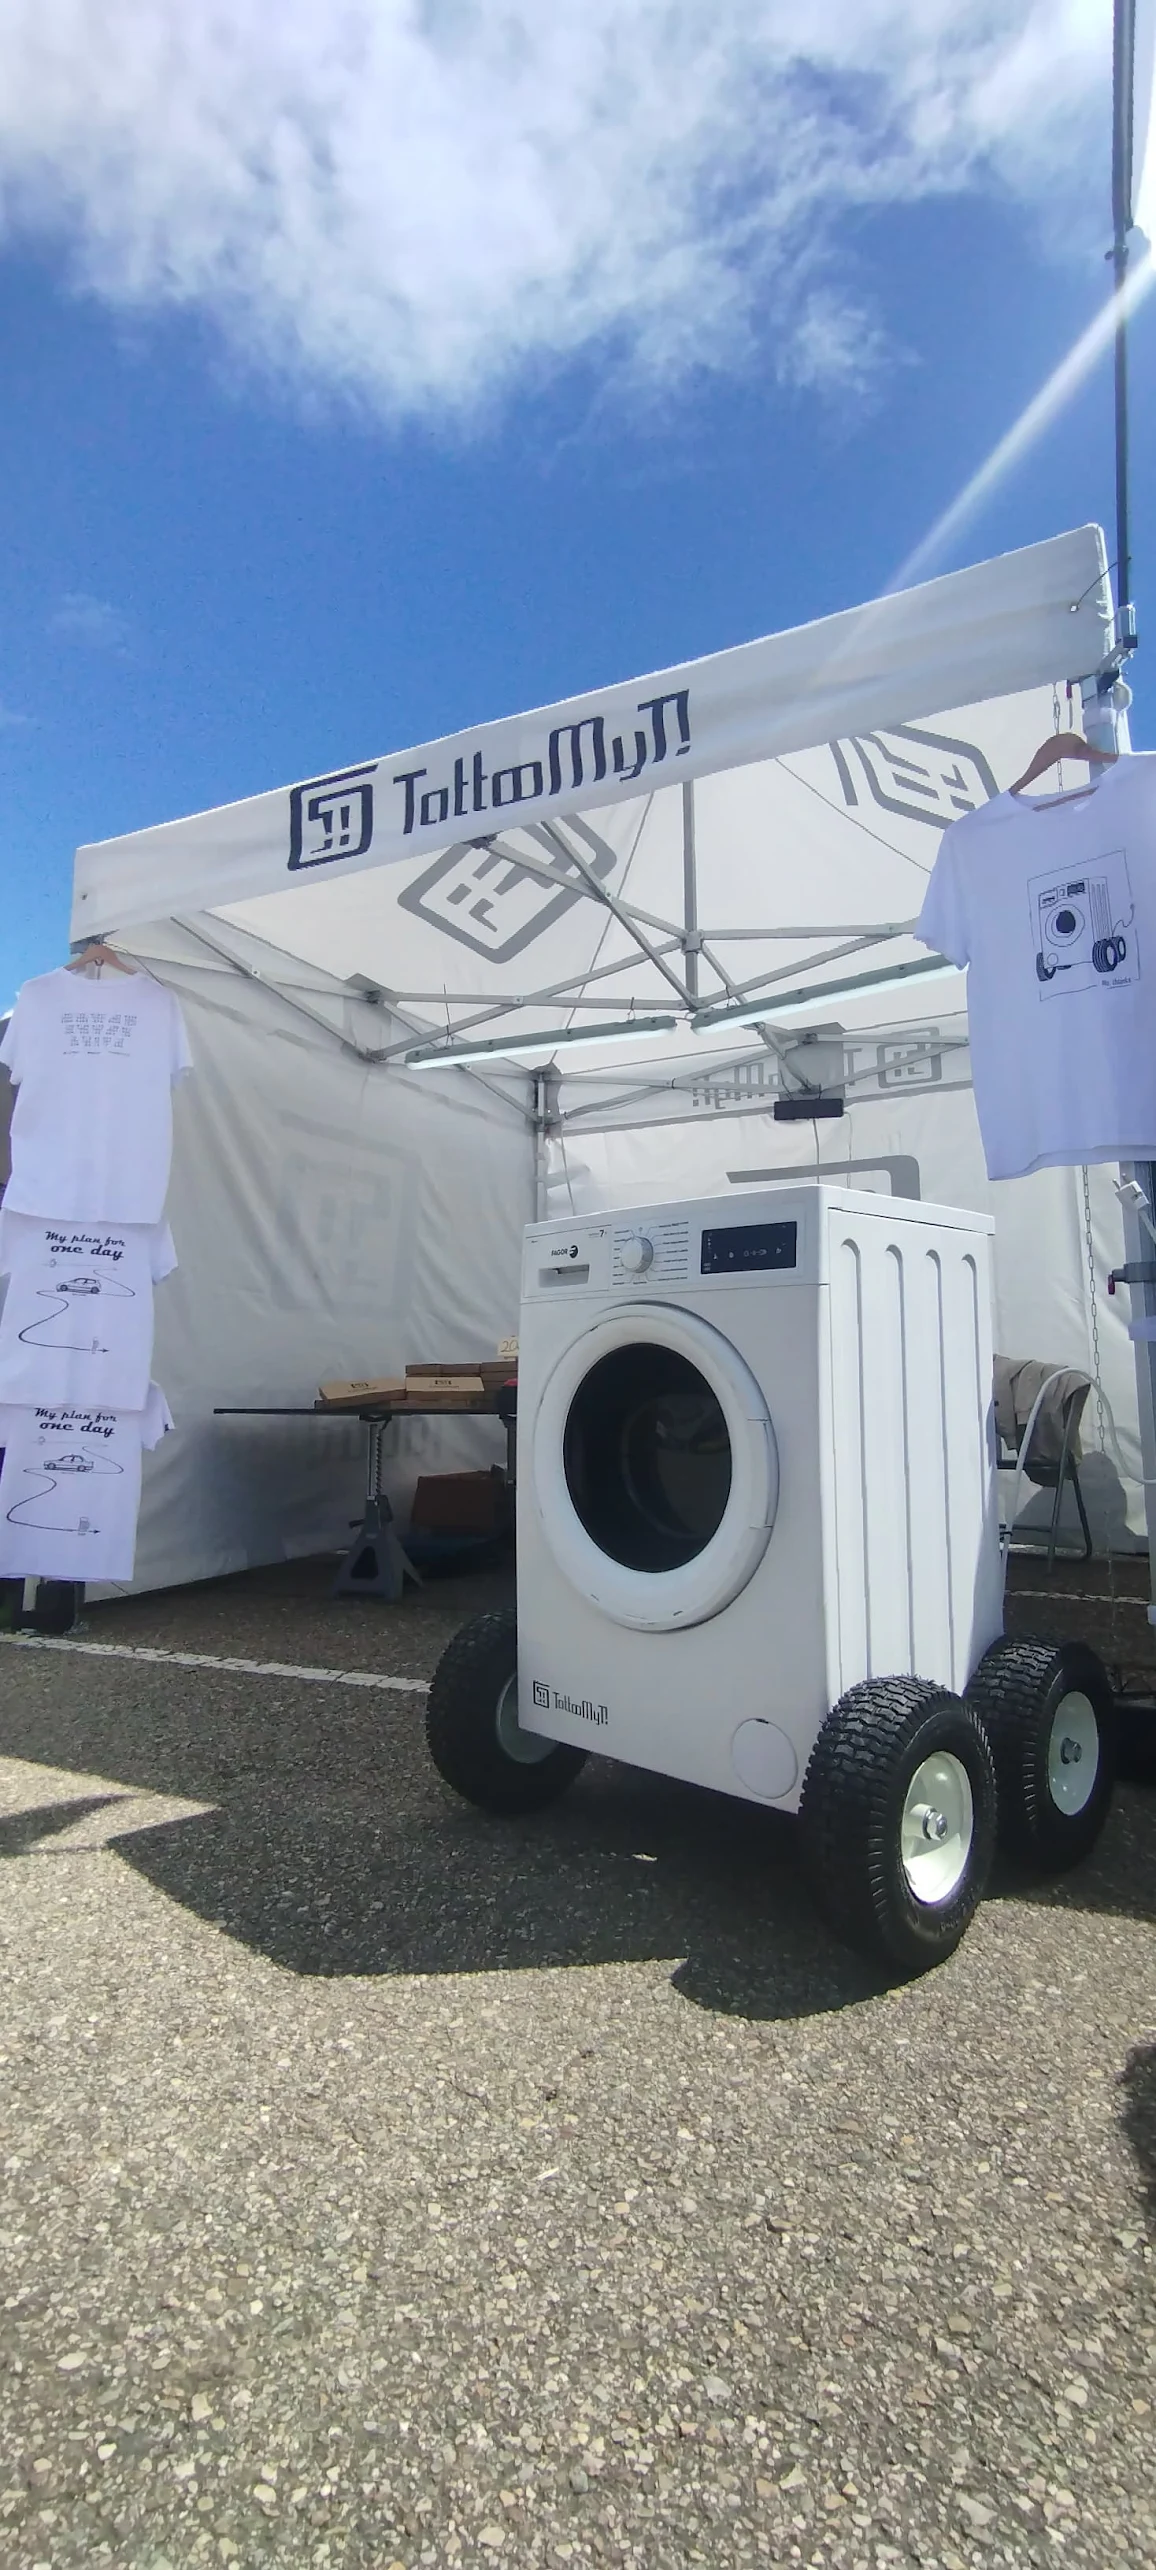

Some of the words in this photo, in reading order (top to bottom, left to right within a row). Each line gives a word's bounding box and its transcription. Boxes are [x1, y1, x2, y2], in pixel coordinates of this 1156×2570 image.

[45, 1231, 68, 1243] My
[71, 1234, 102, 1244] plan
[104, 1236, 126, 1247] for
[50, 1244, 84, 1254] one
[90, 1245, 125, 1261] day
[551, 1248, 568, 1257] FAGOR
[34, 1407, 57, 1420] My
[61, 1410, 92, 1422] plan
[95, 1412, 118, 1423] for
[39, 1421, 74, 1431] one
[80, 1421, 116, 1438] day
